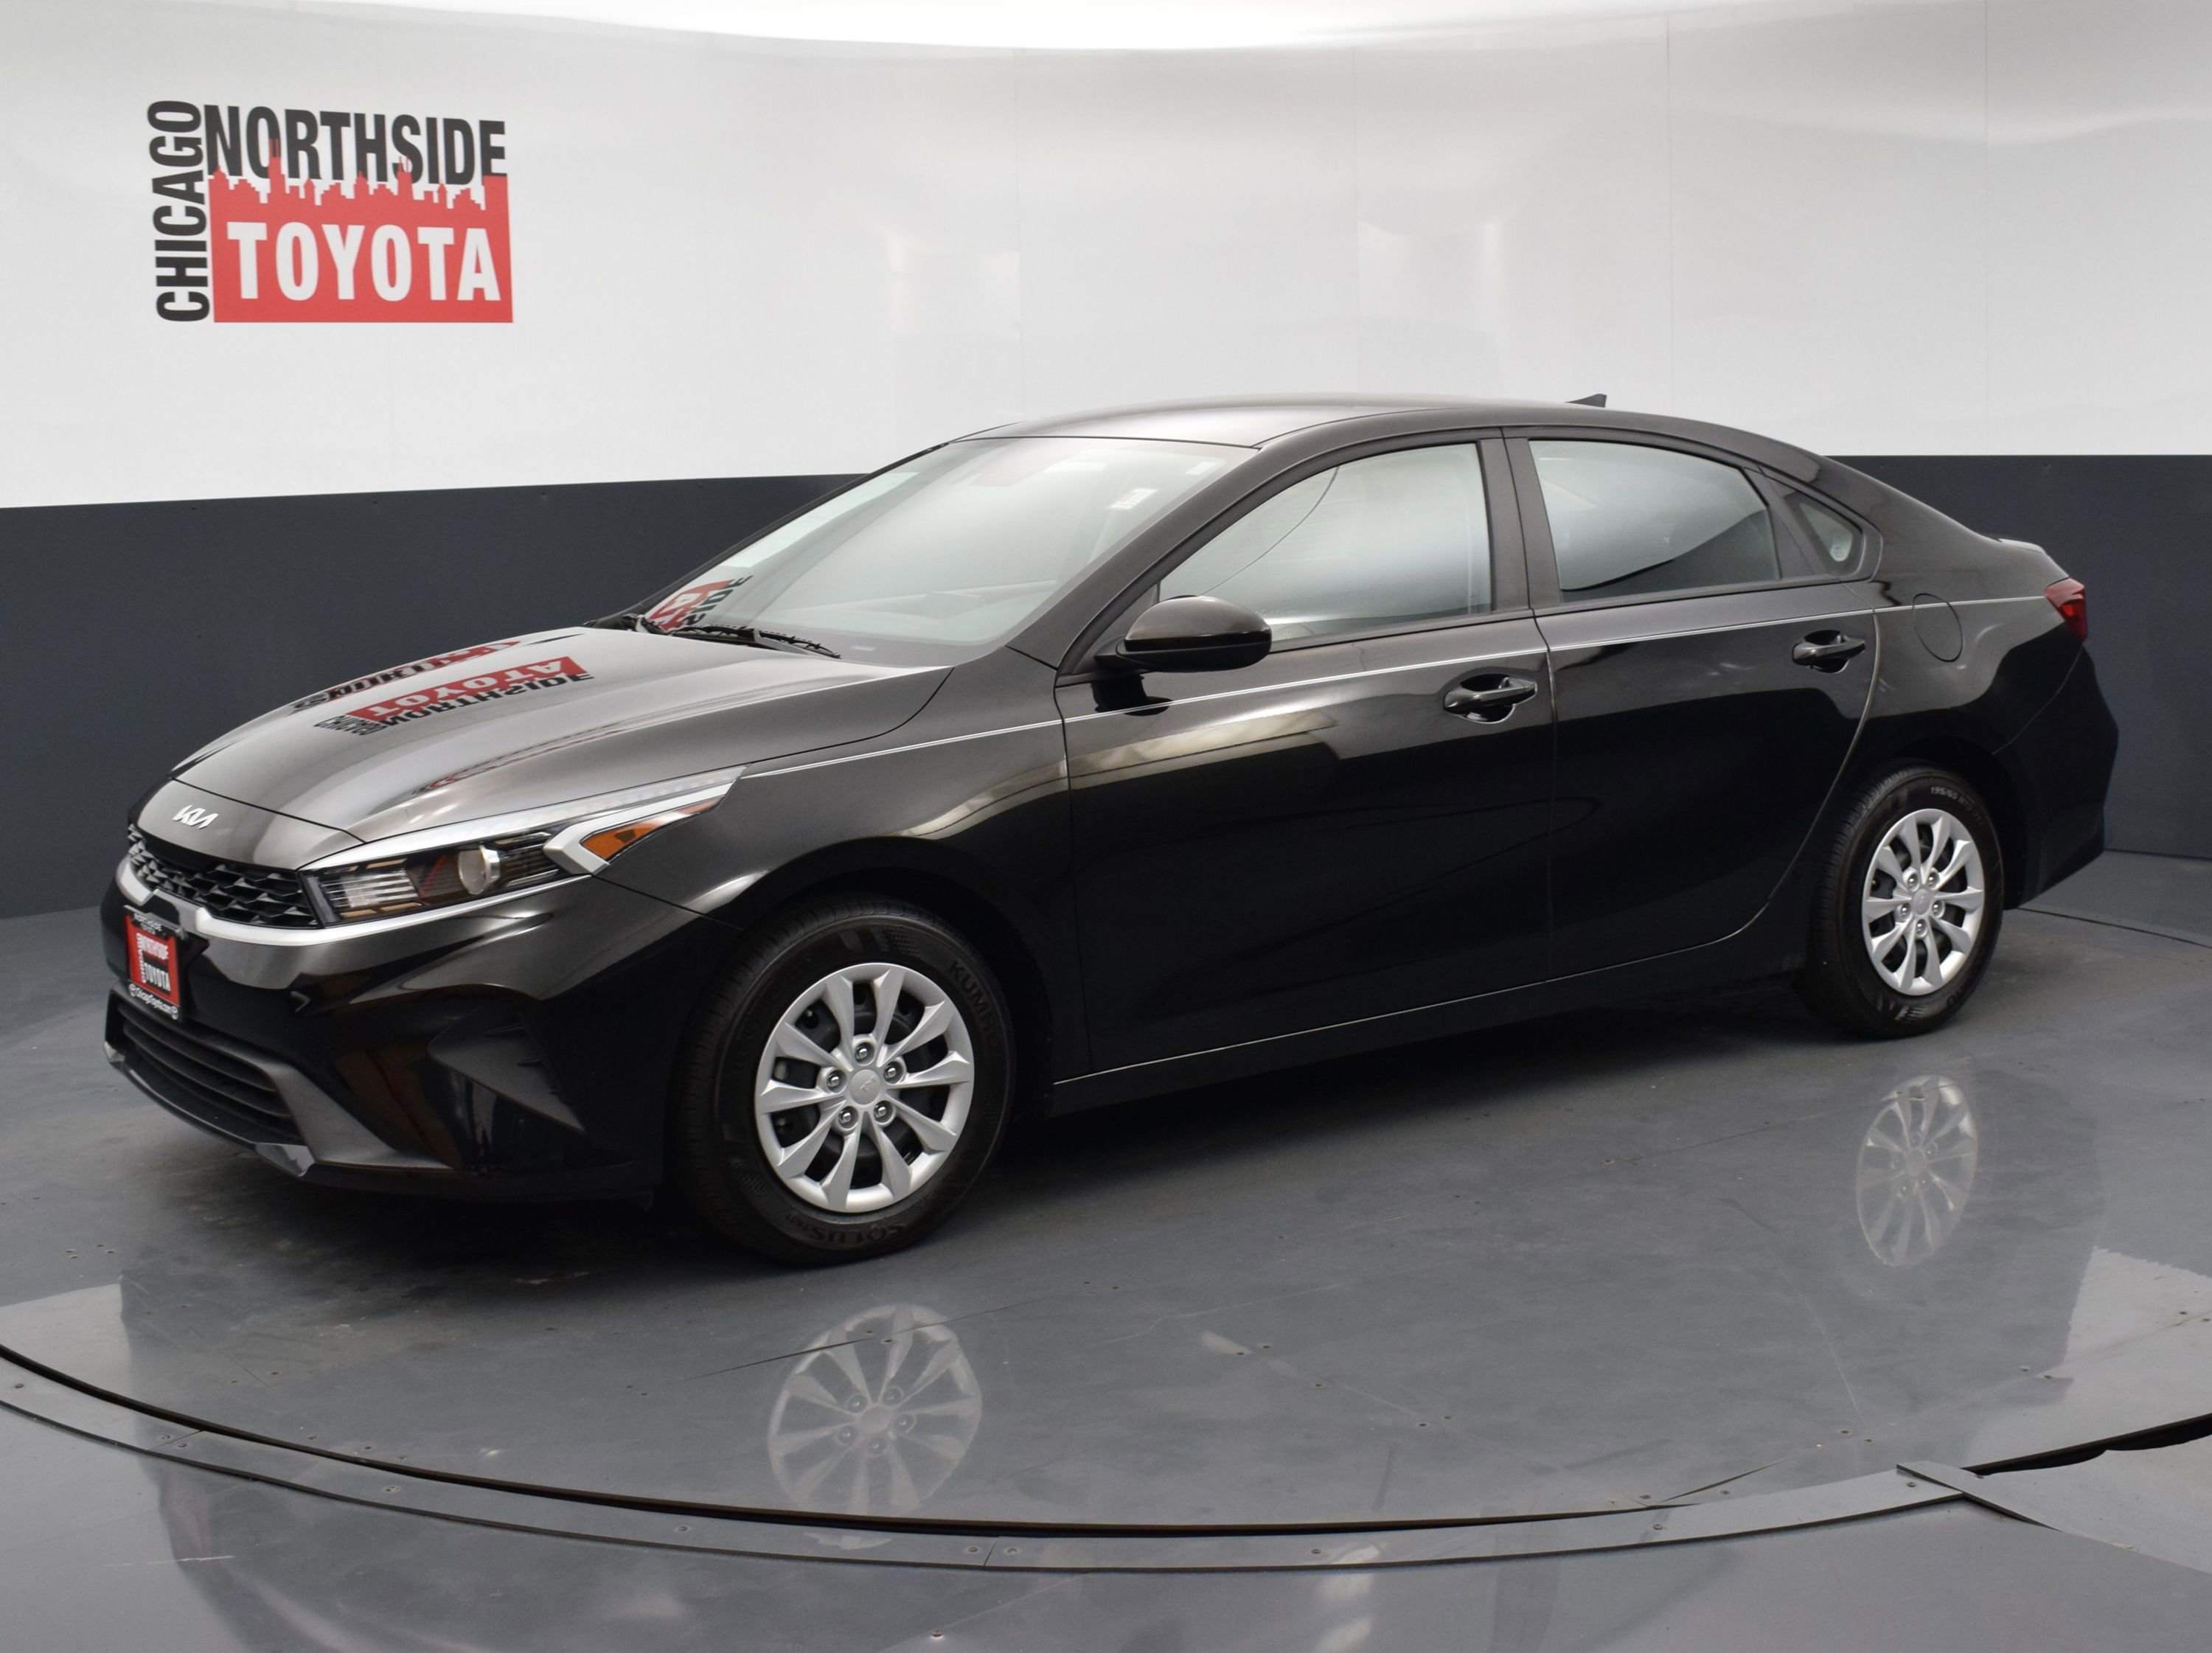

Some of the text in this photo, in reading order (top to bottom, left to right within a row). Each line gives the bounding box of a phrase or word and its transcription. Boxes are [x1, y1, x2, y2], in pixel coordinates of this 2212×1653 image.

[204, 104, 507, 185] NORTHSIDE
[147, 100, 210, 322] CHICAGO
[227, 222, 501, 302] TOYOTA
